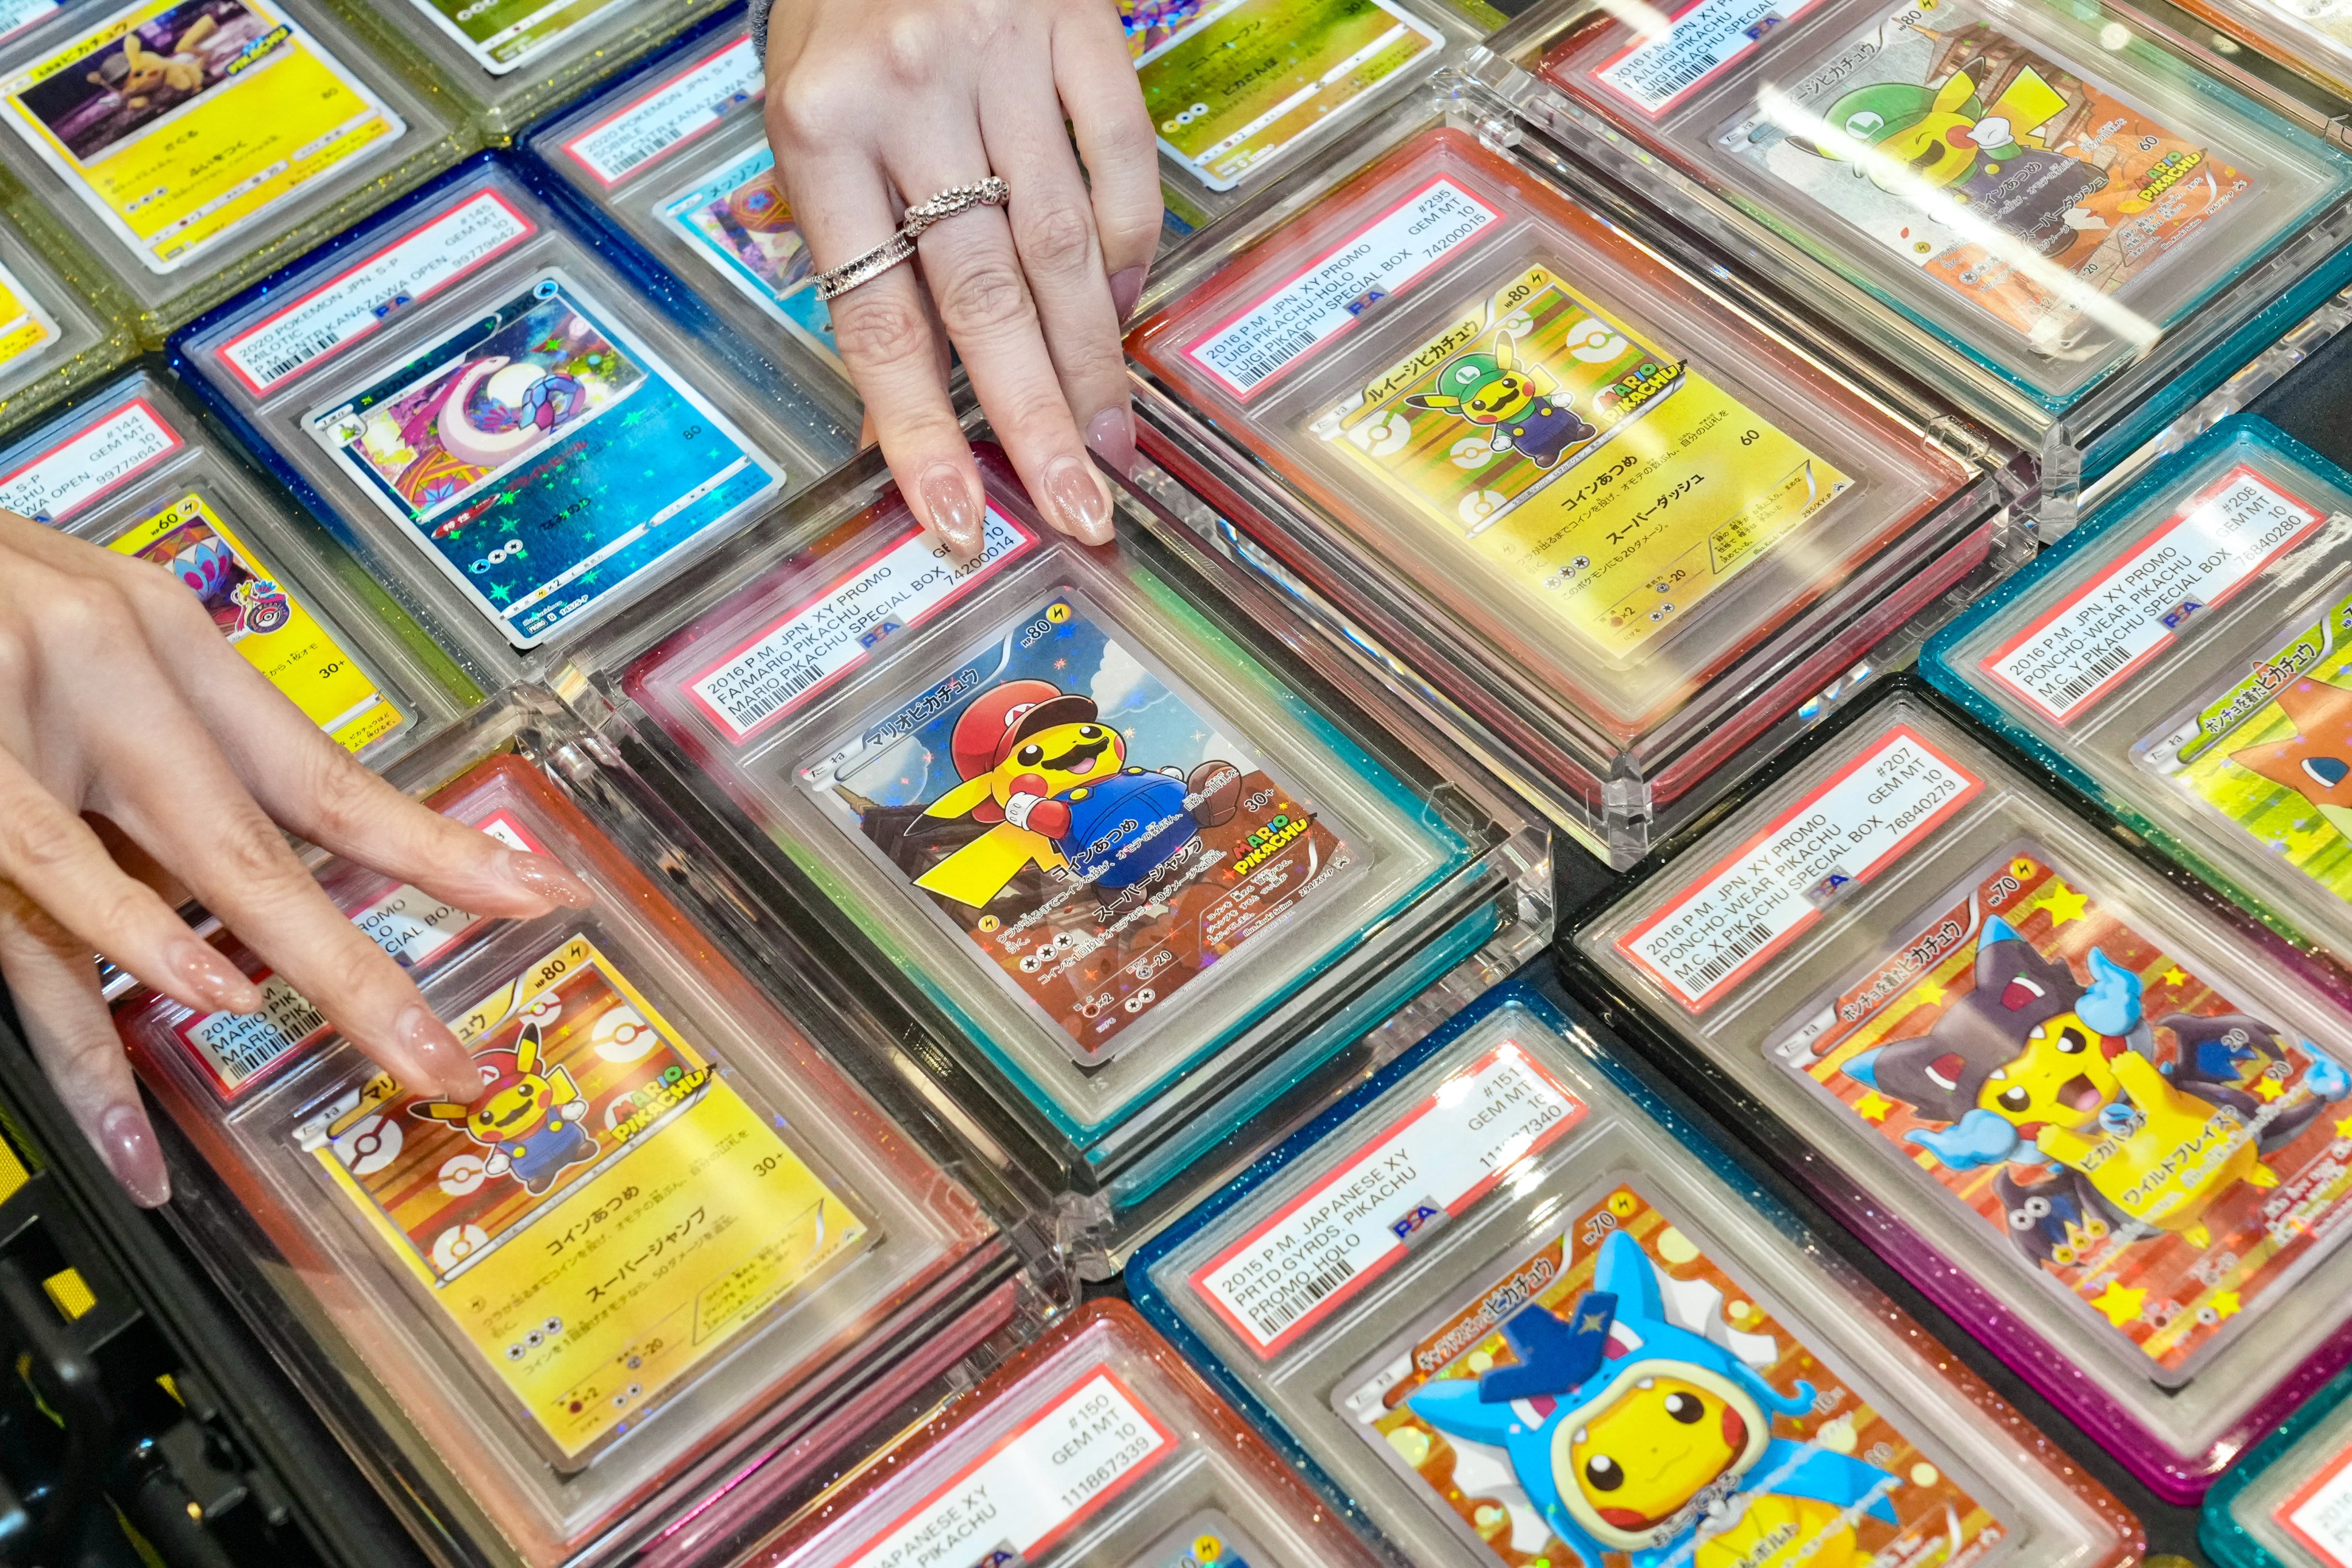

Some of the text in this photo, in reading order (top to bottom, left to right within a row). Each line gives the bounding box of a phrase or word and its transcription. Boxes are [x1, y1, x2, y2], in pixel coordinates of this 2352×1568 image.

[1667, 32, 1725, 74] PIKACHU
[1724, 0, 1778, 32] SPECIAL
[1671, 20, 1699, 40] JPN.
[1697, 5, 1717, 21] XY
[1674, 11, 1732, 52] PIKACHU
[1899, 9, 1924, 25] 80
[2135, 134, 2160, 152] 60
[2131, 149, 2184, 190] MARIO
[2137, 151, 2204, 203] PIKACHU
[1408, 196, 1461, 235] GEM MT
[1418, 189, 1451, 213] #295
[1457, 205, 1476, 218] 10
[444, 211, 497, 246] GEM MT
[492, 218, 508, 230] 10
[1422, 213, 1486, 258] 74200015
[451, 226, 515, 268] 99779642
[238, 257, 398, 358] 2020 POKEMON JPN. S-P
[1206, 244, 1371, 360] 2016 P.M. JPN. XY PROMO
[1227, 248, 1412, 377] LUIGI PIKACHU SPECIAL BOX
[1507, 284, 1532, 302] 80
[1216, 271, 1354, 368] LUIGI PIKACHU-HOLO
[246, 328, 303, 365] MILOTIC
[254, 354, 284, 374] P.M.
[1365, 319, 1482, 403] ルイージピカチュウ
[1596, 361, 1660, 407] MARIO
[1600, 364, 1682, 425] PIKACHU
[88, 424, 145, 461] GEM MT
[106, 415, 140, 439] #144
[138, 432, 156, 445] 10
[681, 423, 704, 441] 80
[1737, 428, 1761, 446] 60
[16, 474, 40, 492] S-P
[95, 440, 163, 484] 99779641
[1560, 453, 1640, 512] コインあつめ
[51, 470, 92, 499] OPEN.
[2222, 486, 2257, 513] #208
[159, 513, 179, 530] 60
[1605, 471, 1705, 544] スーパーダッシュ
[2213, 495, 2270, 539] GEM MT
[2267, 505, 2288, 519] 10
[984, 526, 1005, 540] 10
[2233, 513, 2304, 567] 76840280
[943, 535, 1014, 585] 74200014
[706, 567, 891, 694] 2016 P.M. JPN. XY PROMO
[1025, 617, 1053, 640] 80
[2009, 546, 2176, 676] 2016 P.M. JPN. XY PROMO
[2022, 555, 2192, 686] PONCHO-WEAR. PIKACHU
[2037, 547, 2231, 698] M.C. Y PIKACHU SPECIAL BOX
[716, 604, 860, 705] FA/MARIO PIKACHU
[727, 565, 945, 715] MARIO PIKACHU SPECIAL BOX
[319, 659, 345, 679] 30+
[864, 666, 983, 751] マリオピカチュウ
[1867, 757, 1925, 804] GEM MT
[1876, 747, 1910, 778] #207
[1922, 768, 1943, 785] 10
[1242, 786, 1278, 813] 30+
[1884, 779, 1956, 835] 76840279
[1050, 816, 1140, 882] コインあつめ
[1227, 812, 1292, 860] MARIO
[1233, 816, 1311, 875] PIKACHU
[1646, 814, 1826, 956] 2016 P.M. JPN. XY PROMO
[1658, 823, 1841, 967] PONCHO-WEAR. PIKACHU
[1673, 814, 1883, 980] M.C. X PIKACHU SPECIAL BOX
[1990, 875, 2021, 899] 70
[539, 958, 567, 980] 80
[210, 1011, 268, 1055] MARIO
[220, 1023, 278, 1066] MARIO
[608, 1063, 686, 1122] MARIO
[1467, 1079, 1532, 1130] GEM MT
[1483, 1067, 1520, 1098] #151
[609, 1068, 709, 1144] PIKACHU
[751, 1149, 788, 1178] 30+
[1342, 1166, 1416, 1225] PIKACHU
[544, 1184, 642, 1257] コインあつめ
[1221, 1148, 1408, 1293] 2015 P.M. JAPANESE XY
[1585, 1209, 1619, 1237] 70
[1248, 1233, 1361, 1322] PROMO-HOLO
[1068, 1393, 1109, 1430] #150
[1113, 1421, 1138, 1442] 10
[1051, 1407, 1119, 1465] GEM MT
[1061, 1436, 1149, 1506] 111867339
[961, 1484, 987, 1511] XY
[917, 1503, 997, 1568] PIKACHU
